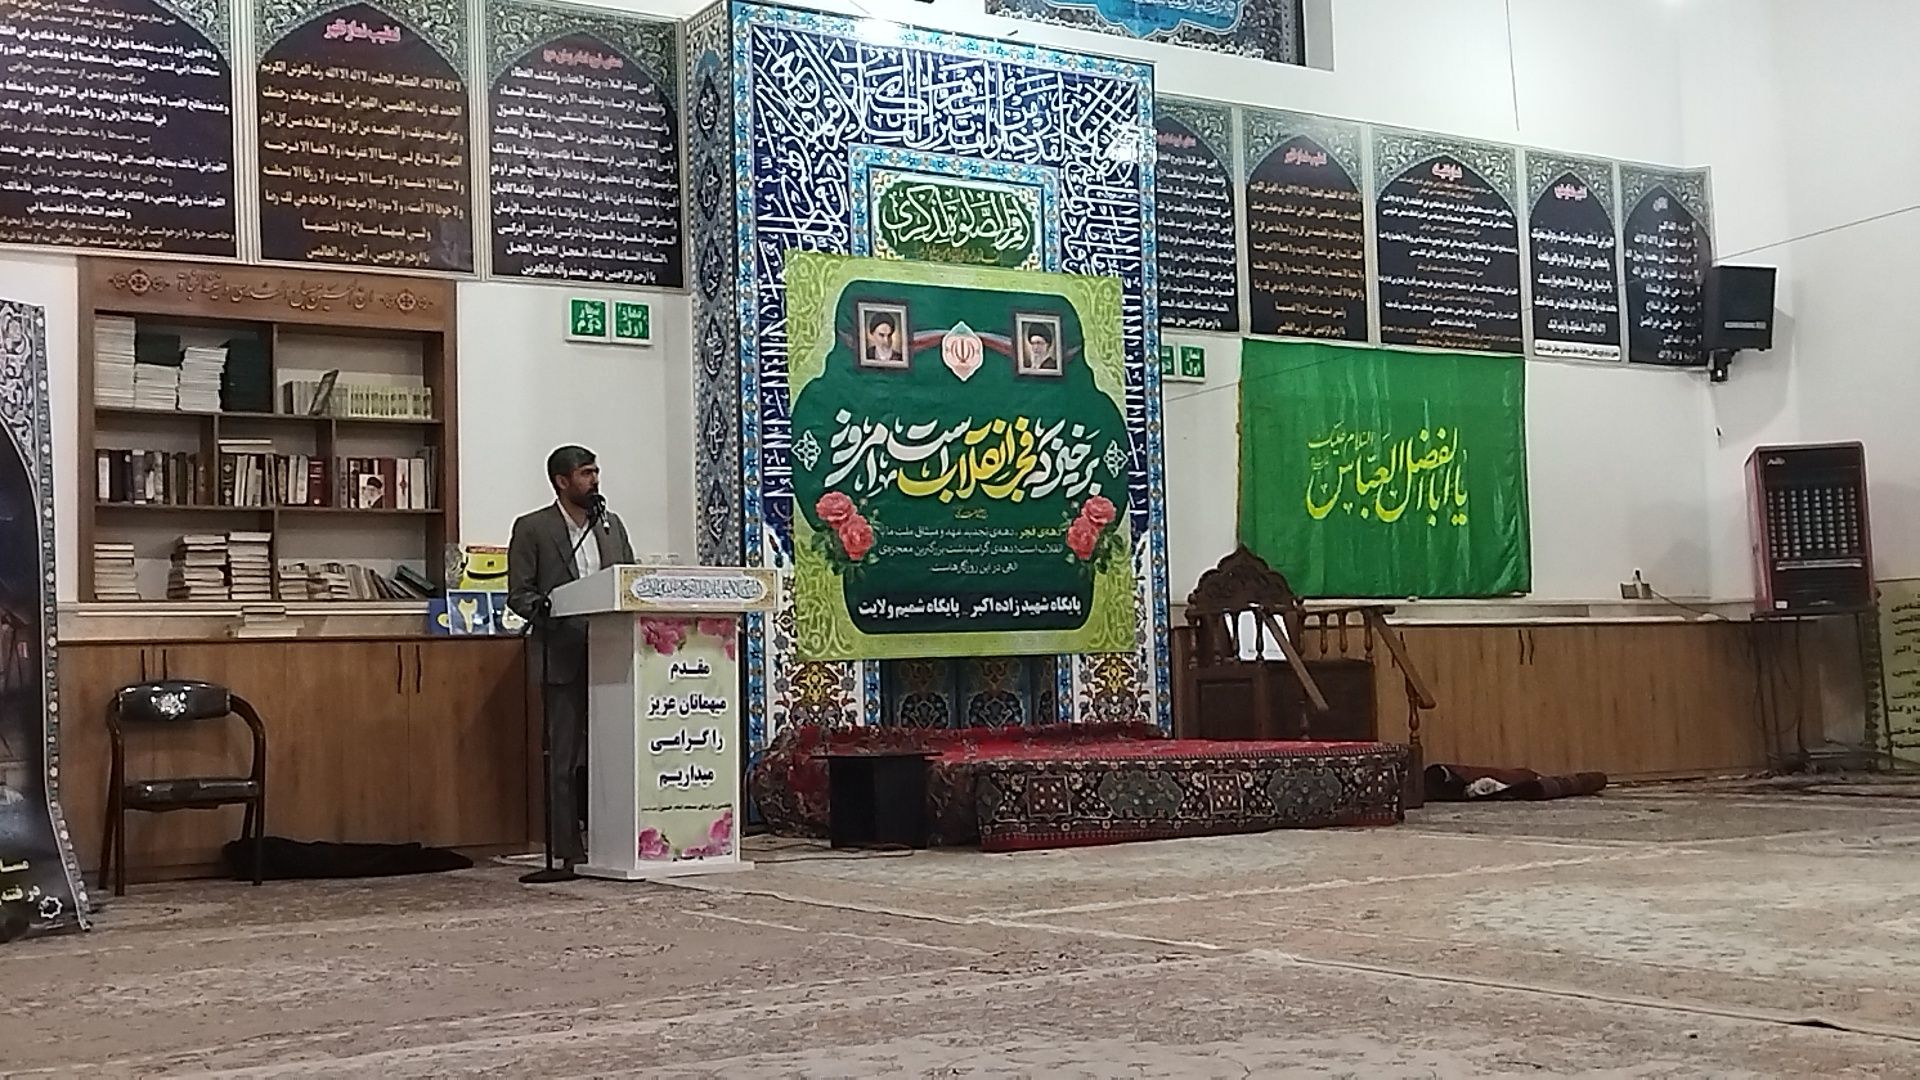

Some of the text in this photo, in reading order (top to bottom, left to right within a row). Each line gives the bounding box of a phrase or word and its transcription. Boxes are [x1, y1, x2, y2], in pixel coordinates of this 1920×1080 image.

[897, 419, 1014, 503] انقلاب
[980, 416, 1037, 502] فجر
[858, 598, 894, 619] ولایت
[895, 598, 926, 618] شمیم
[927, 597, 960, 618] پایگاه
[970, 597, 994, 618] اکبر
[1021, 597, 1049, 616] شهید
[1050, 596, 1082, 616] پایگاه
[669, 659, 710, 679] مقدم
[648, 694, 727, 716] میهمانان عزیز
[651, 729, 724, 751] را گرامی
[659, 765, 714, 788] میداریم
